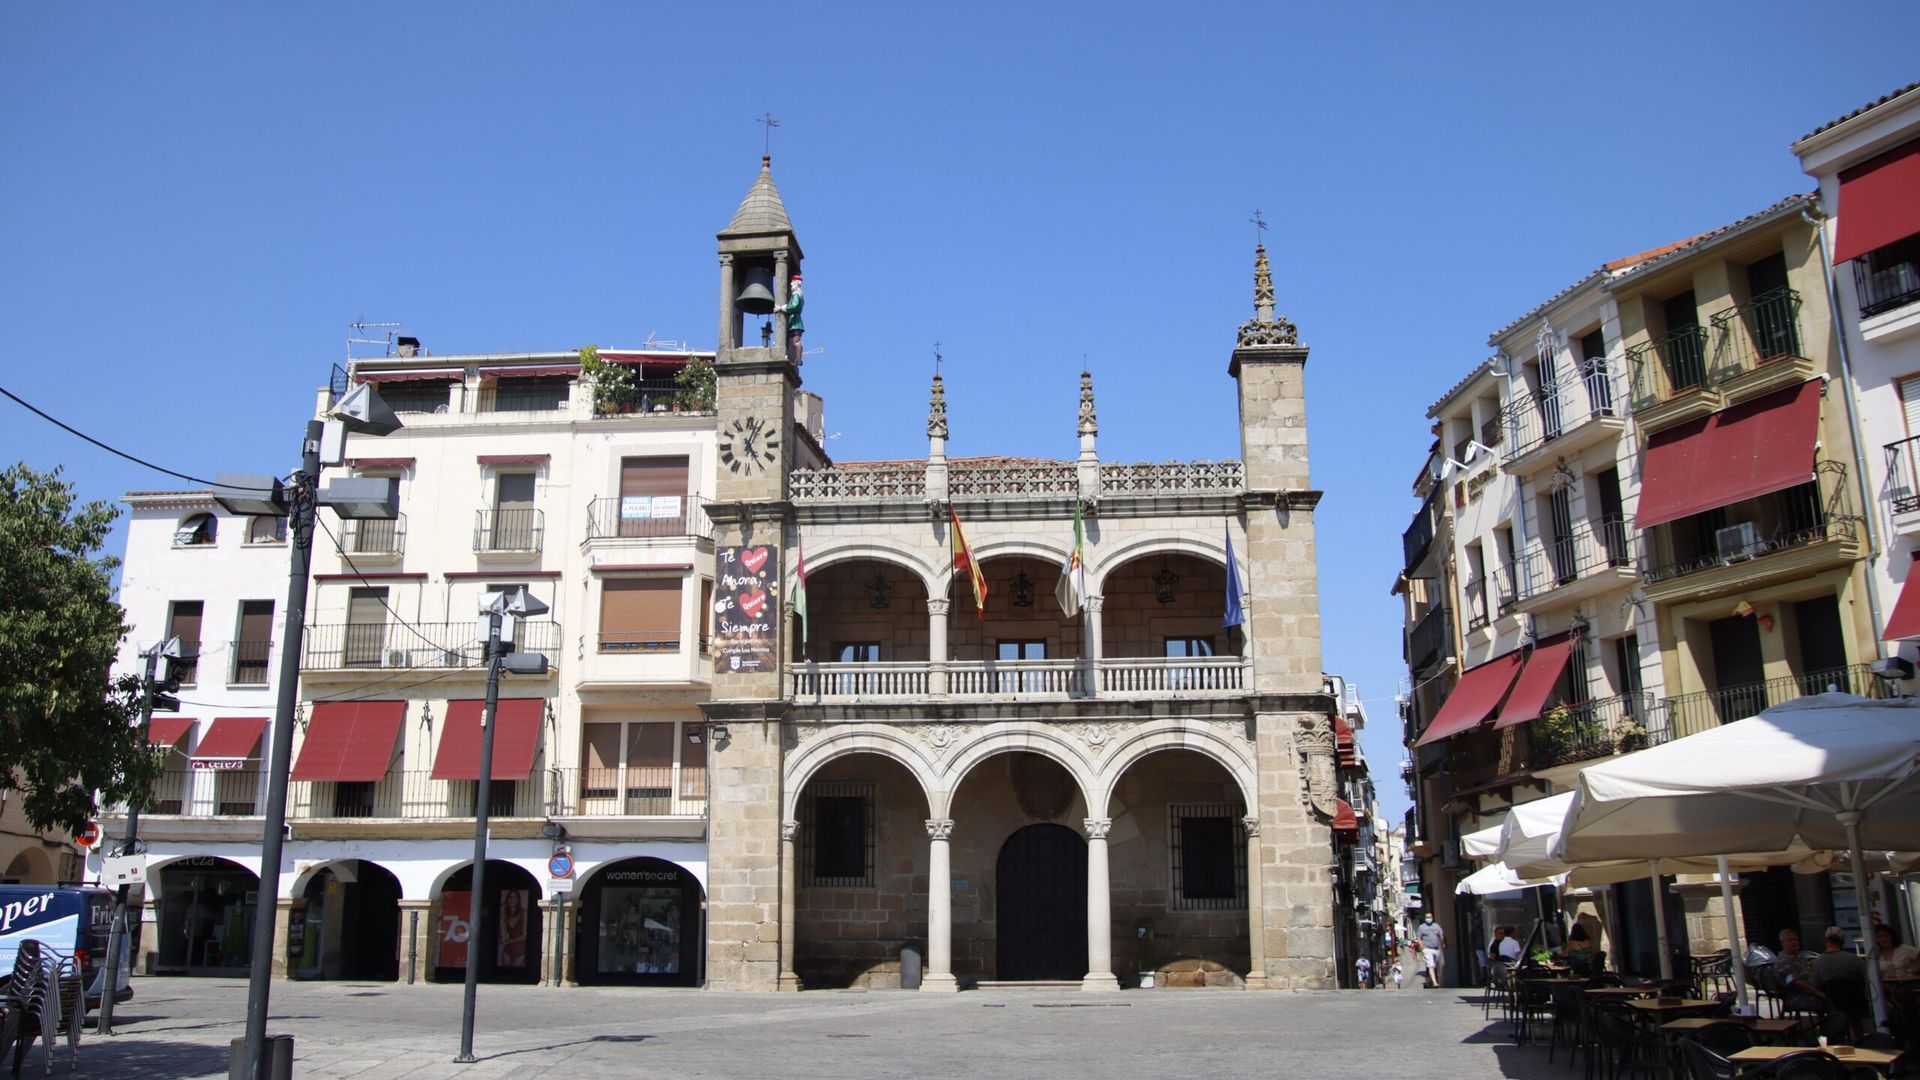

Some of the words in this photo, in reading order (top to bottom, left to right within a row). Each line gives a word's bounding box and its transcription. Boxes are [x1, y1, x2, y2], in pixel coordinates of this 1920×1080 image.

[720, 552, 736, 563] Te
[744, 551, 768, 567] Quiero
[721, 574, 762, 588] Ahora,
[719, 598, 735, 609] Te
[742, 594, 766, 610] Quiero
[720, 621, 770, 638] Siempre
[208, 760, 243, 769] cereza
[172, 856, 215, 866] ereza
